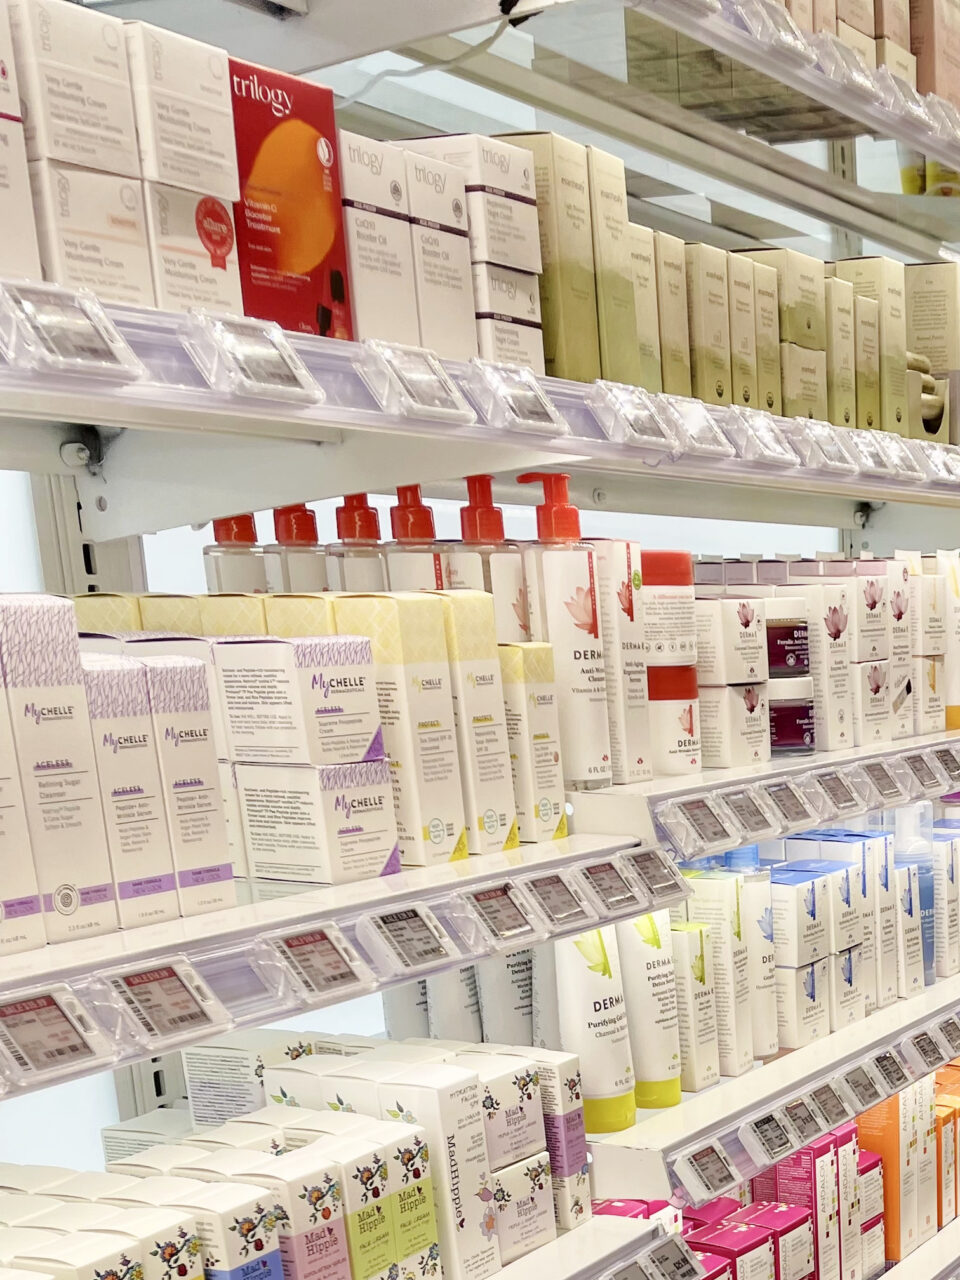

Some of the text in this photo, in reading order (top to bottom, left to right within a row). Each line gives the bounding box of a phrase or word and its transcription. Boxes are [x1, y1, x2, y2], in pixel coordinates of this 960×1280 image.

[233, 74, 294, 117] trilogy
[348, 144, 383, 176] trilogy
[482, 147, 511, 174] trilogy
[415, 165, 446, 193] trilogy
[203, 217, 227, 233] allure
[491, 276, 518, 300] trilogy
[312, 672, 364, 698] MyCHELLE
[24, 703, 73, 725] MyCHELLE
[103, 733, 148, 754] MyCHELLE
[165, 727, 208, 747] MyCHELLE
[335, 794, 383, 819] MyCHELLE
[646, 957, 671, 971] DERMA
[587, 1016, 617, 1030] Purifying
[505, 1108, 519, 1119] Mad
[505, 1112, 527, 1127] Hippie
[398, 1186, 417, 1203] Mad
[399, 1193, 427, 1214] Hippie
[516, 1198, 530, 1209] Mad
[357, 1207, 377, 1223] Mad
[517, 1203, 537, 1218] Hippie
[359, 1214, 386, 1235] Hippie
[304, 1228, 327, 1246] Mad
[306, 1236, 339, 1257] Hippie
[241, 1259, 261, 1277] Mad
